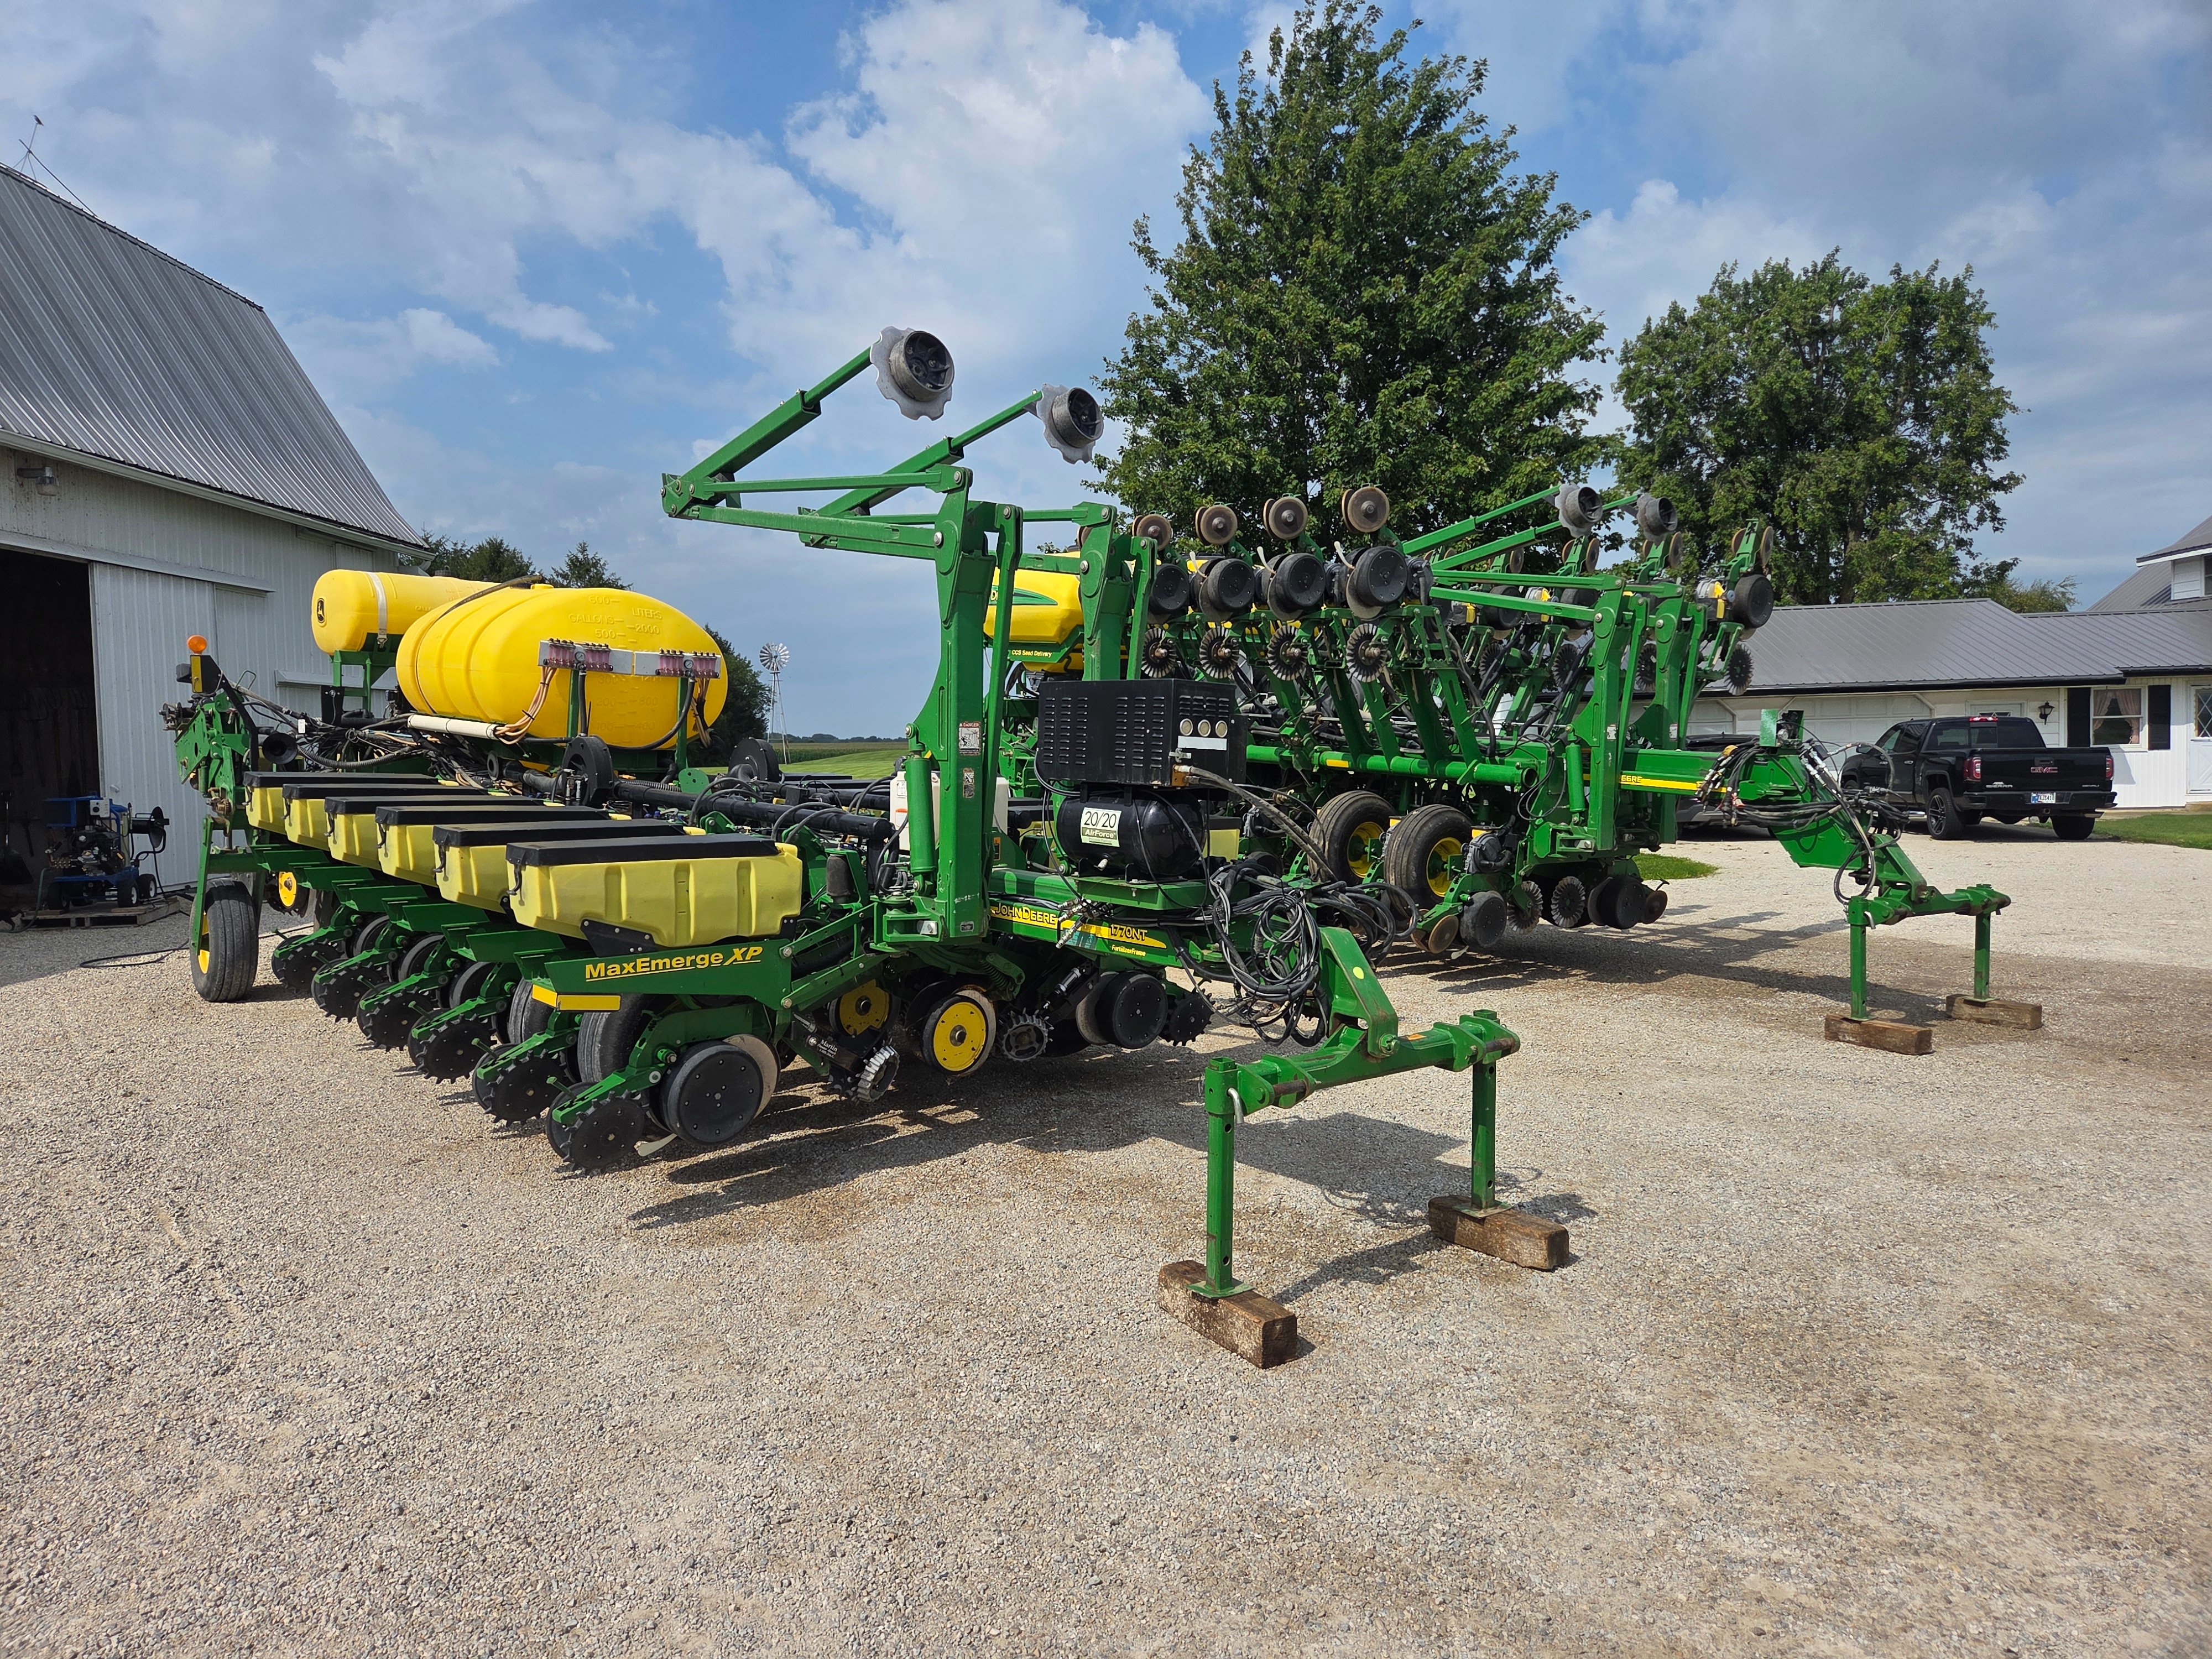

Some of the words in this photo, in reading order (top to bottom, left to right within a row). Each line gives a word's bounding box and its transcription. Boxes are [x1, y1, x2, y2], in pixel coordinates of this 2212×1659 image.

[588, 596, 610, 604] 600
[568, 614, 614, 624] GALLONS
[632, 608, 662, 619] LITERS
[595, 628, 616, 639] 500
[636, 623, 660, 635] 2000
[1084, 811, 1117, 828] 20/20
[995, 904, 1022, 919] JOHN
[1021, 906, 1057, 925] DEERE
[1110, 924, 1148, 941] 1770NT
[585, 952, 723, 979] MaxEmerge
[722, 946, 763, 966] XP
[820, 1039, 838, 1052] Martin
